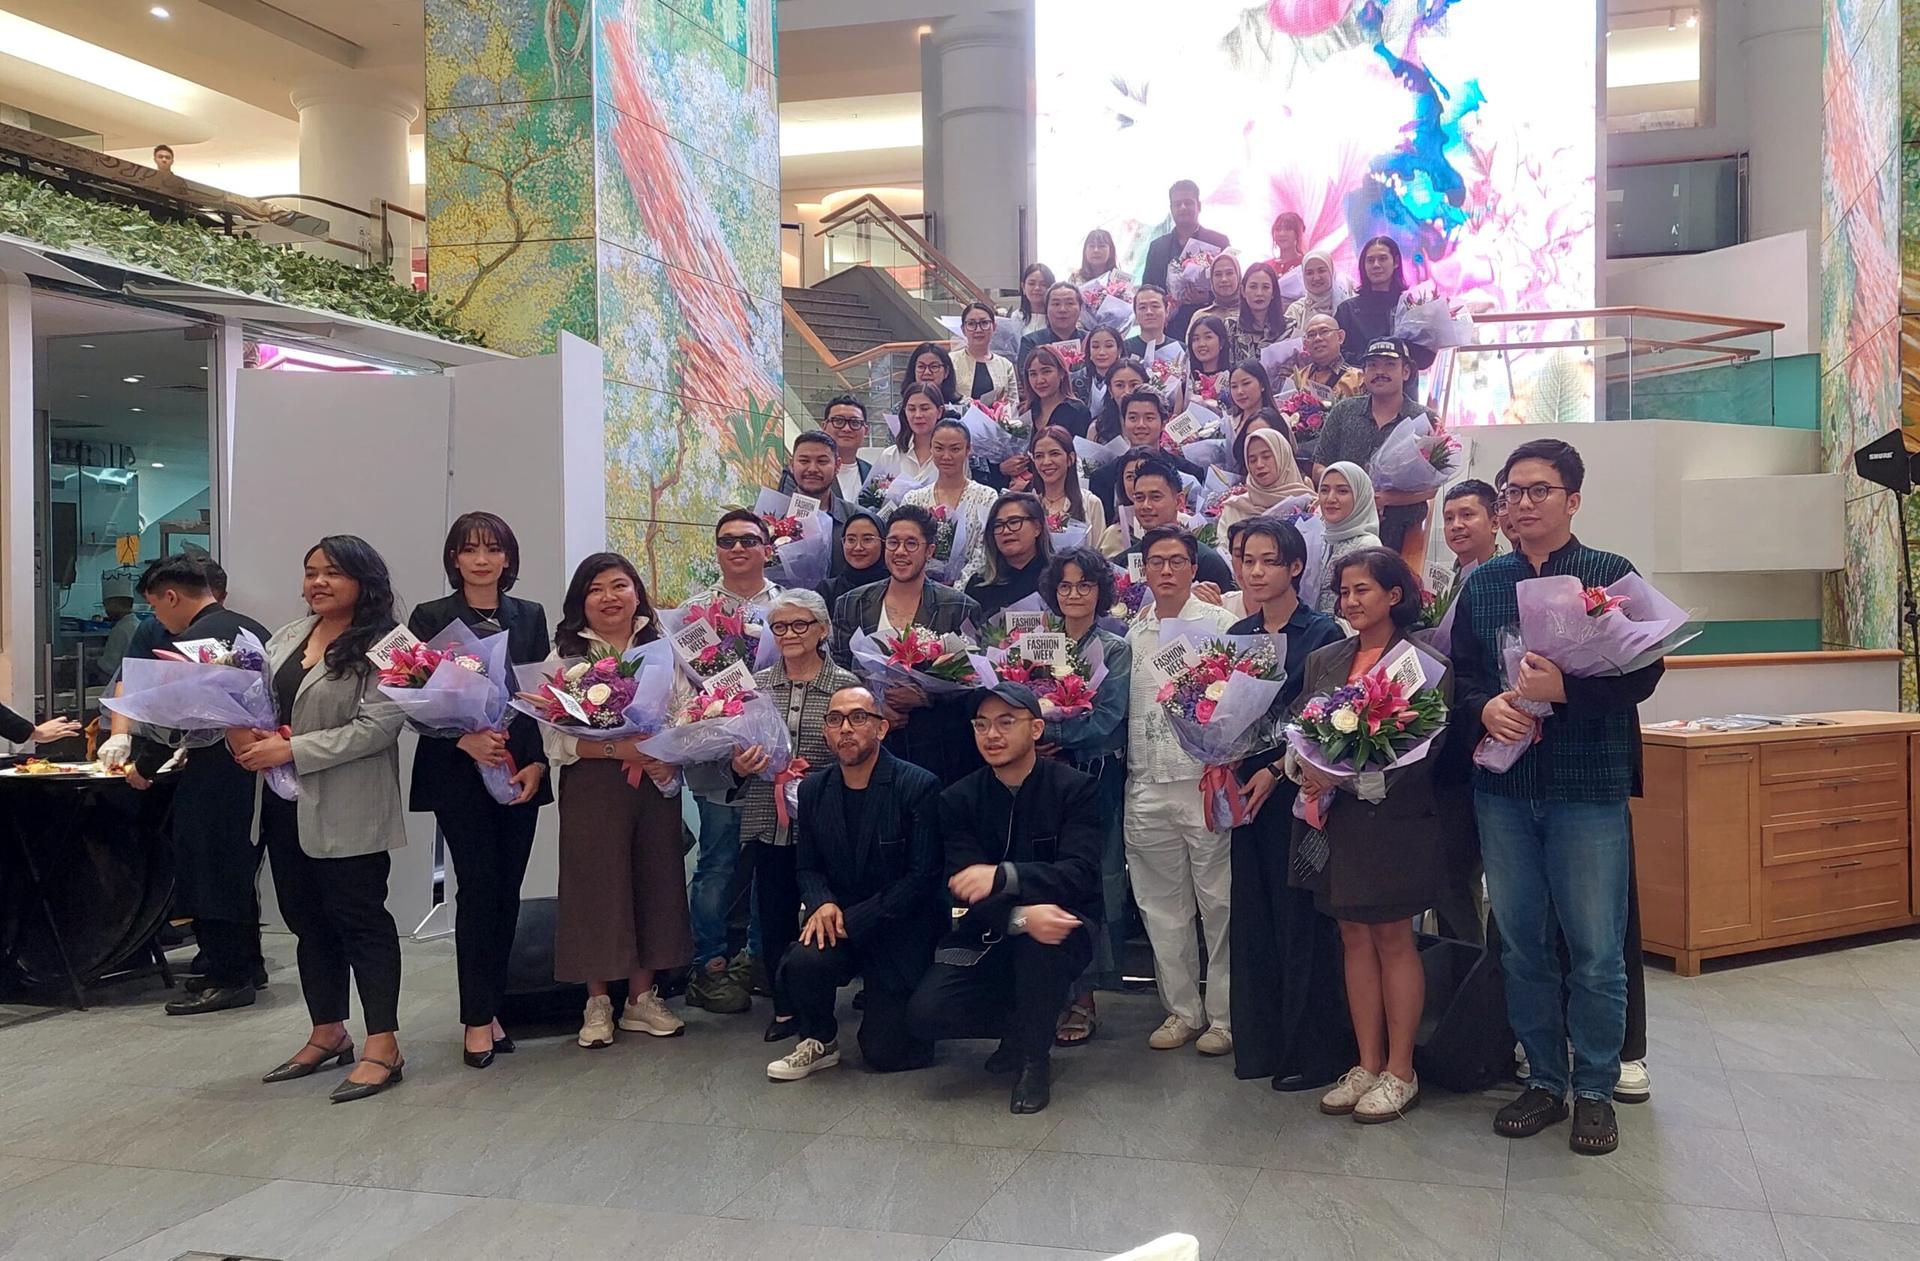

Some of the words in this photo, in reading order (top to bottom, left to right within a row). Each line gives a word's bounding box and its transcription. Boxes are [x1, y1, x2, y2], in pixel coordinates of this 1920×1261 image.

[1170, 415, 1191, 433] FASHION
[1178, 424, 1193, 436] WEEK
[795, 499, 815, 511] FASHION
[1429, 568, 1450, 586] FASHION
[1012, 617, 1040, 627] FASHION
[678, 625, 707, 648] FASHION
[688, 637, 709, 653] WEEK
[1027, 639, 1059, 650] FASHION
[1033, 650, 1054, 660] WEEK
[1153, 643, 1187, 671] FASHION
[1164, 657, 1188, 677] WEEK
[1401, 656, 1419, 688] FASHION
